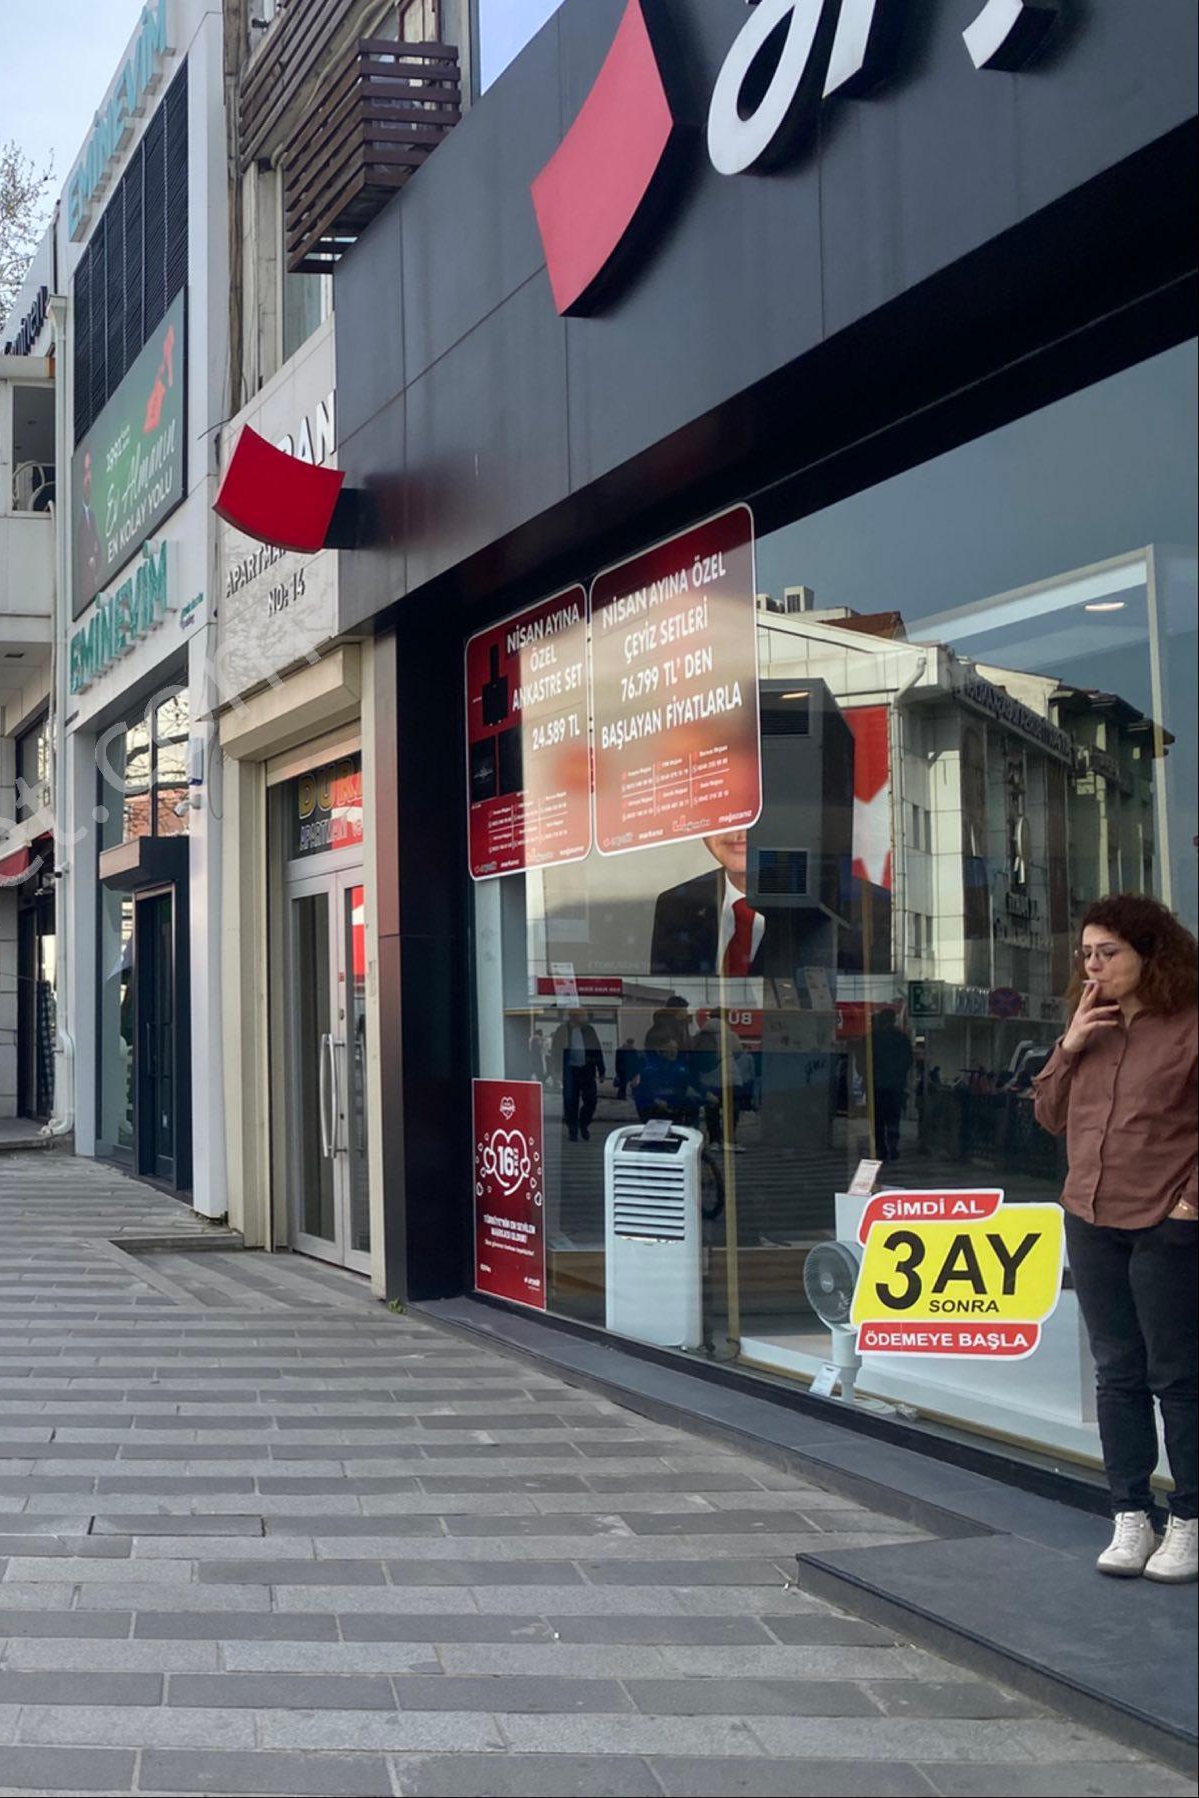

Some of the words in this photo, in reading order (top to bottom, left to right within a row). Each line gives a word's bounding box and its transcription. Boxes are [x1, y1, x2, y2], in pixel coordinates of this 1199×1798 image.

[106, 538, 121, 564] EN
[121, 506, 146, 553] KOLAY
[146, 465, 173, 527] YOLU
[602, 591, 647, 629] NİSAN
[650, 568, 688, 600] AYINA
[692, 551, 726, 587] ÖZEL
[507, 622, 544, 654] NİSAN
[544, 603, 580, 635] AYINA
[624, 626, 657, 664] ÇEYİZ
[660, 595, 708, 640] SETLERİ
[530, 645, 557, 673] ÖZEL
[620, 666, 659, 703] 76.799
[685, 646, 713, 681] DEN
[512, 674, 562, 711] ANKASTRE
[564, 662, 583, 692] SET
[568, 716, 580, 738] TL
[602, 708, 662, 751] BAŞLAYAN
[666, 680, 742, 730] FİYATLARLA
[497, 1145, 514, 1177] 16
[882, 1198, 945, 1219] ŞİMDİ
[951, 1201, 985, 1214] AL
[875, 1230, 926, 1311] 3
[931, 1232, 1043, 1296] AY
[928, 1299, 1000, 1313] SONRA
[864, 1330, 953, 1347] ÖDEMEYE
[958, 1332, 1028, 1350] BAŞLA
